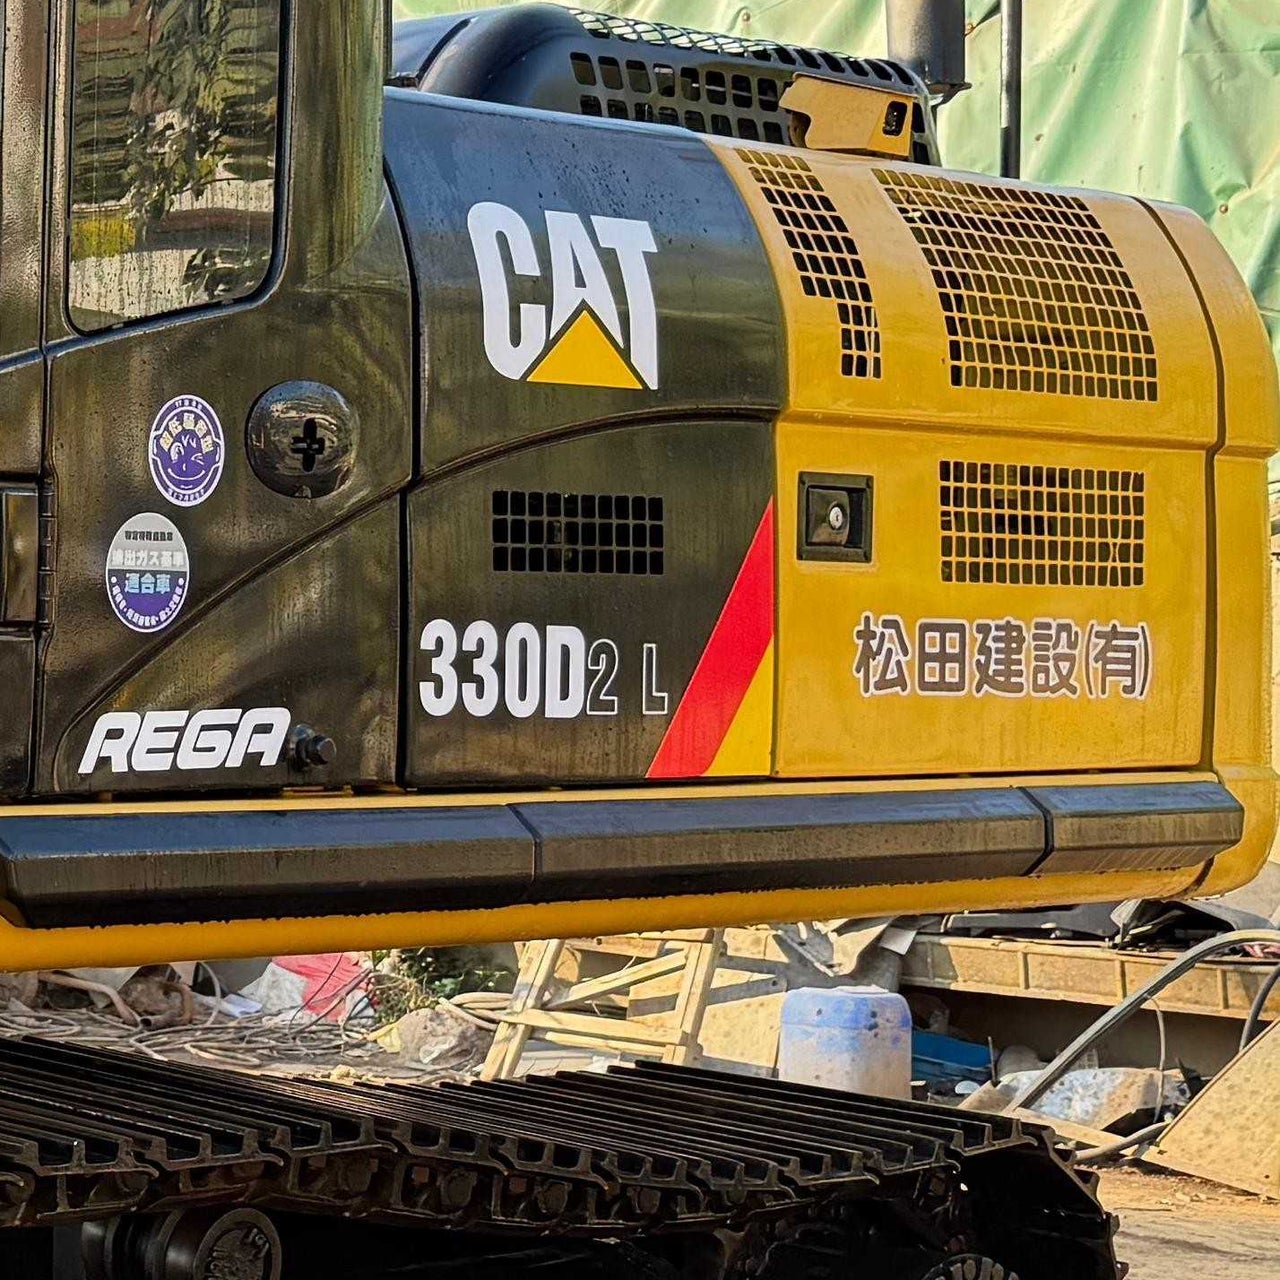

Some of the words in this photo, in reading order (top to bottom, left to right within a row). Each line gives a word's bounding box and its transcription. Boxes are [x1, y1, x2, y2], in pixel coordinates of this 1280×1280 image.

[467, 201, 659, 391] CAT
[642, 642, 668, 716] L
[77, 706, 292, 774] REGA
